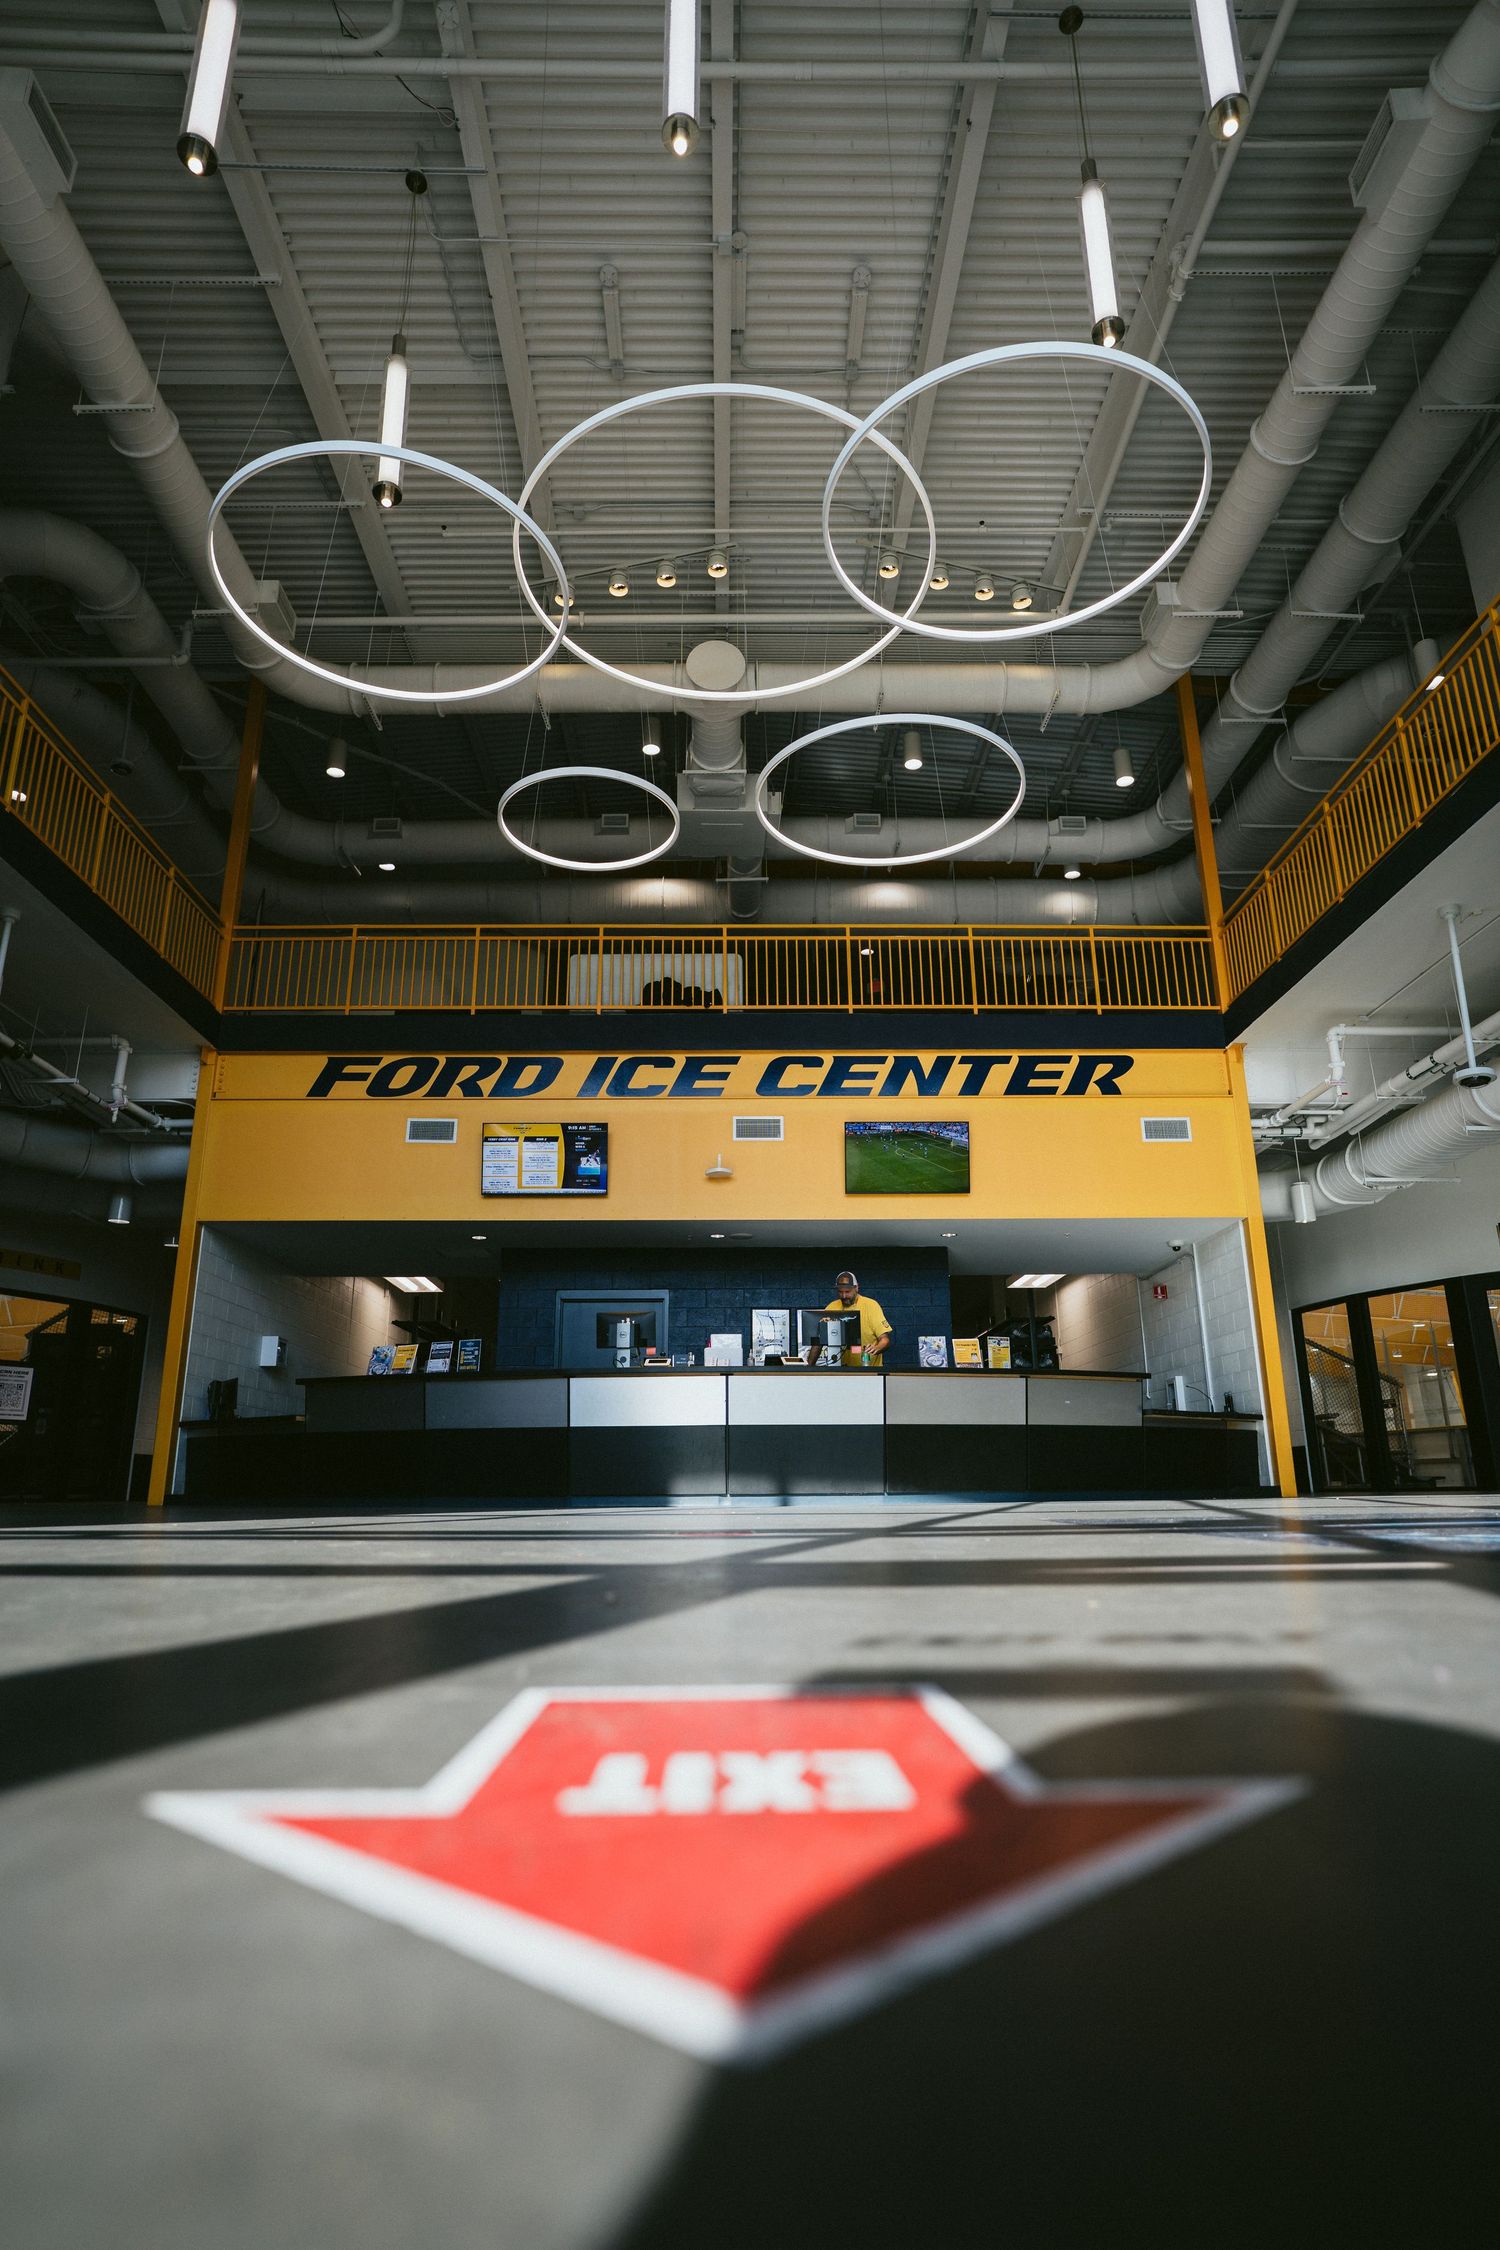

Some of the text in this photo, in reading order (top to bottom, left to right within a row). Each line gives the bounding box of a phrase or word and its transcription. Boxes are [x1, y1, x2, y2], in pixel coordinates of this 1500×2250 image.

[305, 1055, 1135, 1097] FORD ICE CENTER
[556, 1749, 917, 1816] EXIT
